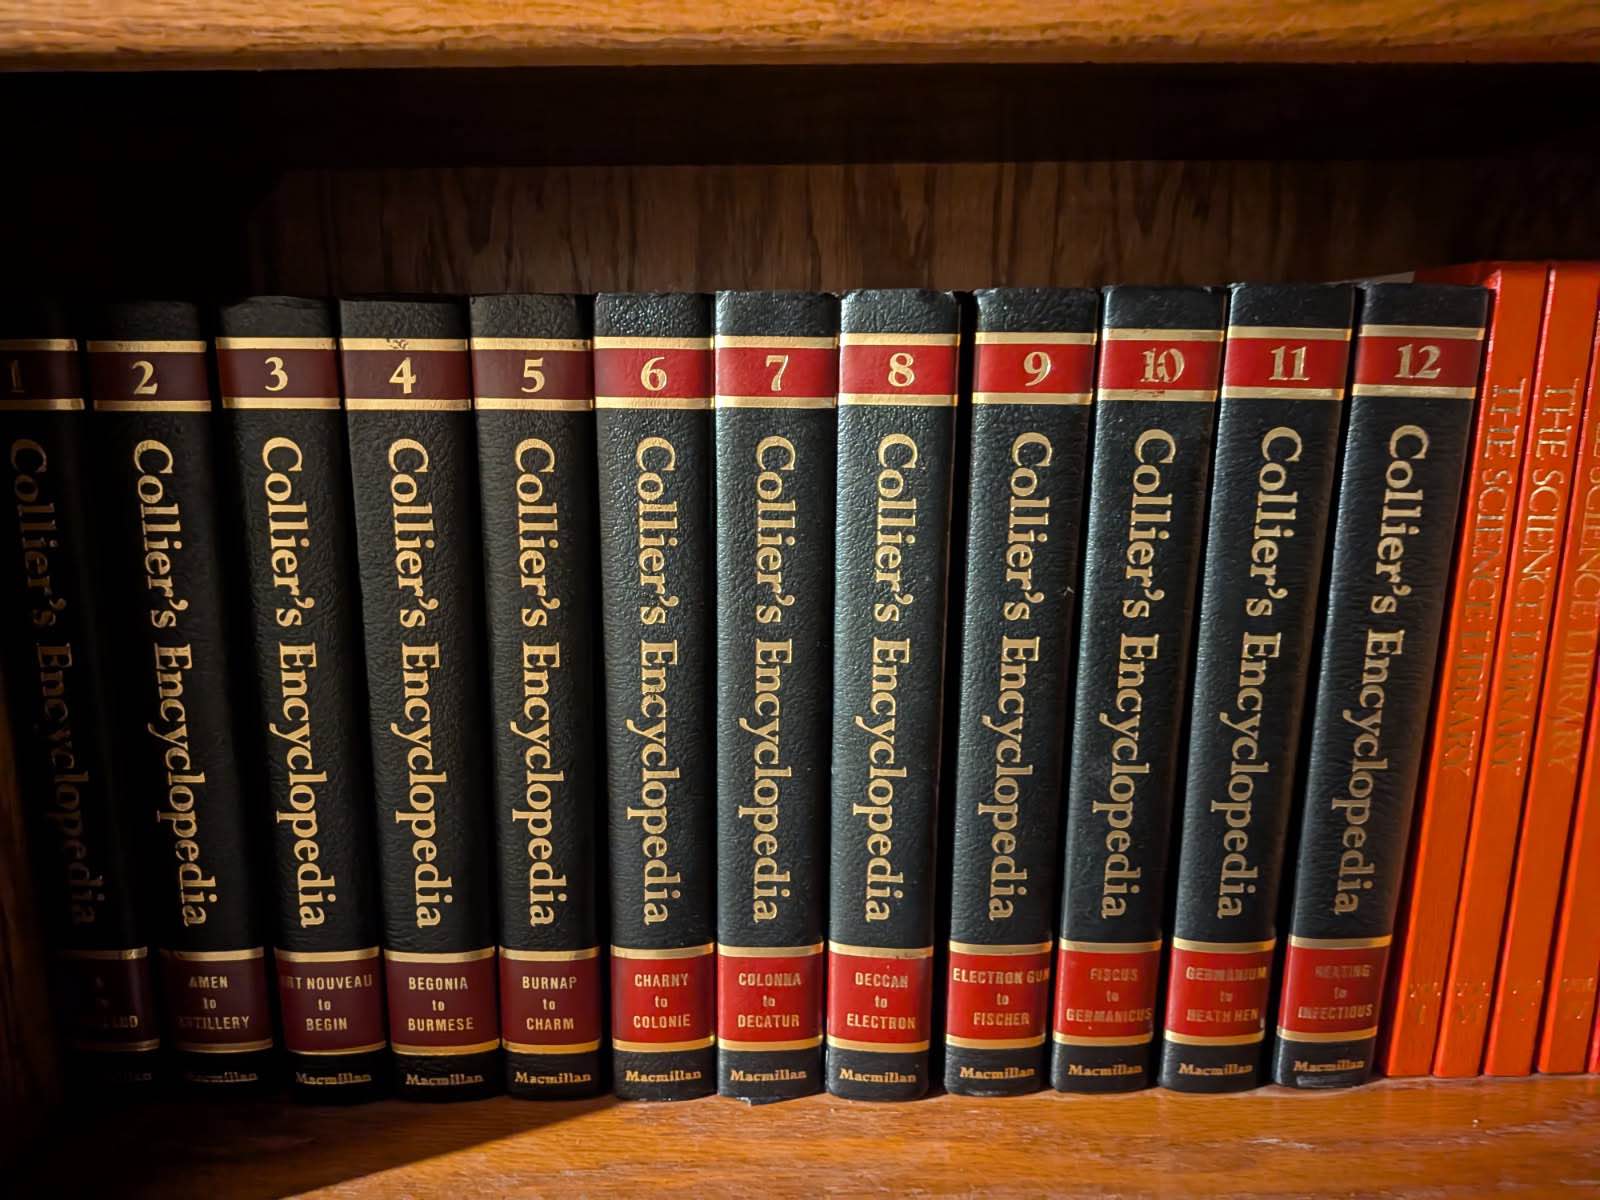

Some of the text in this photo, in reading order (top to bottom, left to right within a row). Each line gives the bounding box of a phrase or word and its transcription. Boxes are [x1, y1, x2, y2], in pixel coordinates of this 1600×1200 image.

[887, 352, 916, 387] 8
[1023, 351, 1052, 386] 9
[1140, 347, 1186, 384] 10
[1269, 346, 1310, 381] 11
[1394, 344, 1443, 379] 12
[132, 360, 158, 395] 2
[264, 357, 289, 391] 3
[389, 357, 417, 394] 4
[521, 357, 545, 393] 5
[640, 357, 667, 391] 6
[765, 355, 789, 391] 7
[1484, 378, 1527, 459] THE
[1536, 378, 1580, 460] THE
[9, 438, 67, 632] Collier's
[1465, 468, 1513, 622] SCIENCE
[1516, 468, 1565, 622] SCIENCE
[853, 433, 918, 922] Collier's Encyclopedia
[978, 432, 1053, 921] Collier's Encyclopedia
[1092, 428, 1177, 919] Collier's Encyclopedia
[1210, 426, 1302, 919] Collier's Encyclopedia
[1332, 424, 1429, 916] Collier's Encyclopedia
[133, 439, 218, 927] Collier's Encyclopedia
[262, 436, 336, 928] Collier's Encyclopedia
[387, 438, 453, 928] Collier's Encyclopedia
[510, 438, 568, 927] Collier's Encyclopedia
[626, 436, 681, 926] Collier's Encyclopedia
[738, 435, 797, 923] Collier's Encyclopedia
[188, 975, 229, 989] AMEN
[307, 974, 373, 990] NOUVEAU
[522, 975, 577, 990] BURNAP
[634, 973, 689, 988] CHARNY
[738, 972, 801, 987] COLONNA
[855, 971, 909, 988] DECCAN
[952, 967, 1024, 984] ELECTRON
[1090, 967, 1138, 982] FISCUS
[408, 976, 469, 991] BEGONIA
[762, 994, 776, 1007] to
[996, 993, 1009, 1006] to
[1106, 990, 1120, 1003] to
[1219, 990, 1233, 1002] to
[1334, 986, 1348, 999] to
[203, 997, 217, 1009] to
[318, 998, 332, 1011] to
[432, 999, 445, 1012] to
[542, 998, 556, 1011] to
[655, 995, 668, 1008] to
[874, 995, 888, 1008] to
[633, 1013, 691, 1029] COLONIE
[737, 1013, 800, 1028] DECATUR
[846, 1013, 917, 1029] ELECTRON
[973, 1011, 1030, 1026] FISCHER
[1066, 1007, 1153, 1023] GERMANICUS
[305, 1017, 349, 1032] BEGIN
[408, 1016, 475, 1032] BURMESE
[526, 1017, 574, 1031] CHARM
[960, 1066, 1035, 1080] Macmillan
[1068, 1064, 1143, 1076] Macmillan
[1178, 1062, 1253, 1076] Macmillan
[1293, 1059, 1365, 1073] Macmillan
[405, 1072, 485, 1086] Macmillan
[514, 1071, 592, 1084] Macmillan
[625, 1069, 702, 1083] Macmillan
[730, 1069, 806, 1082] Macmillan
[839, 1068, 917, 1083] Macmillan
